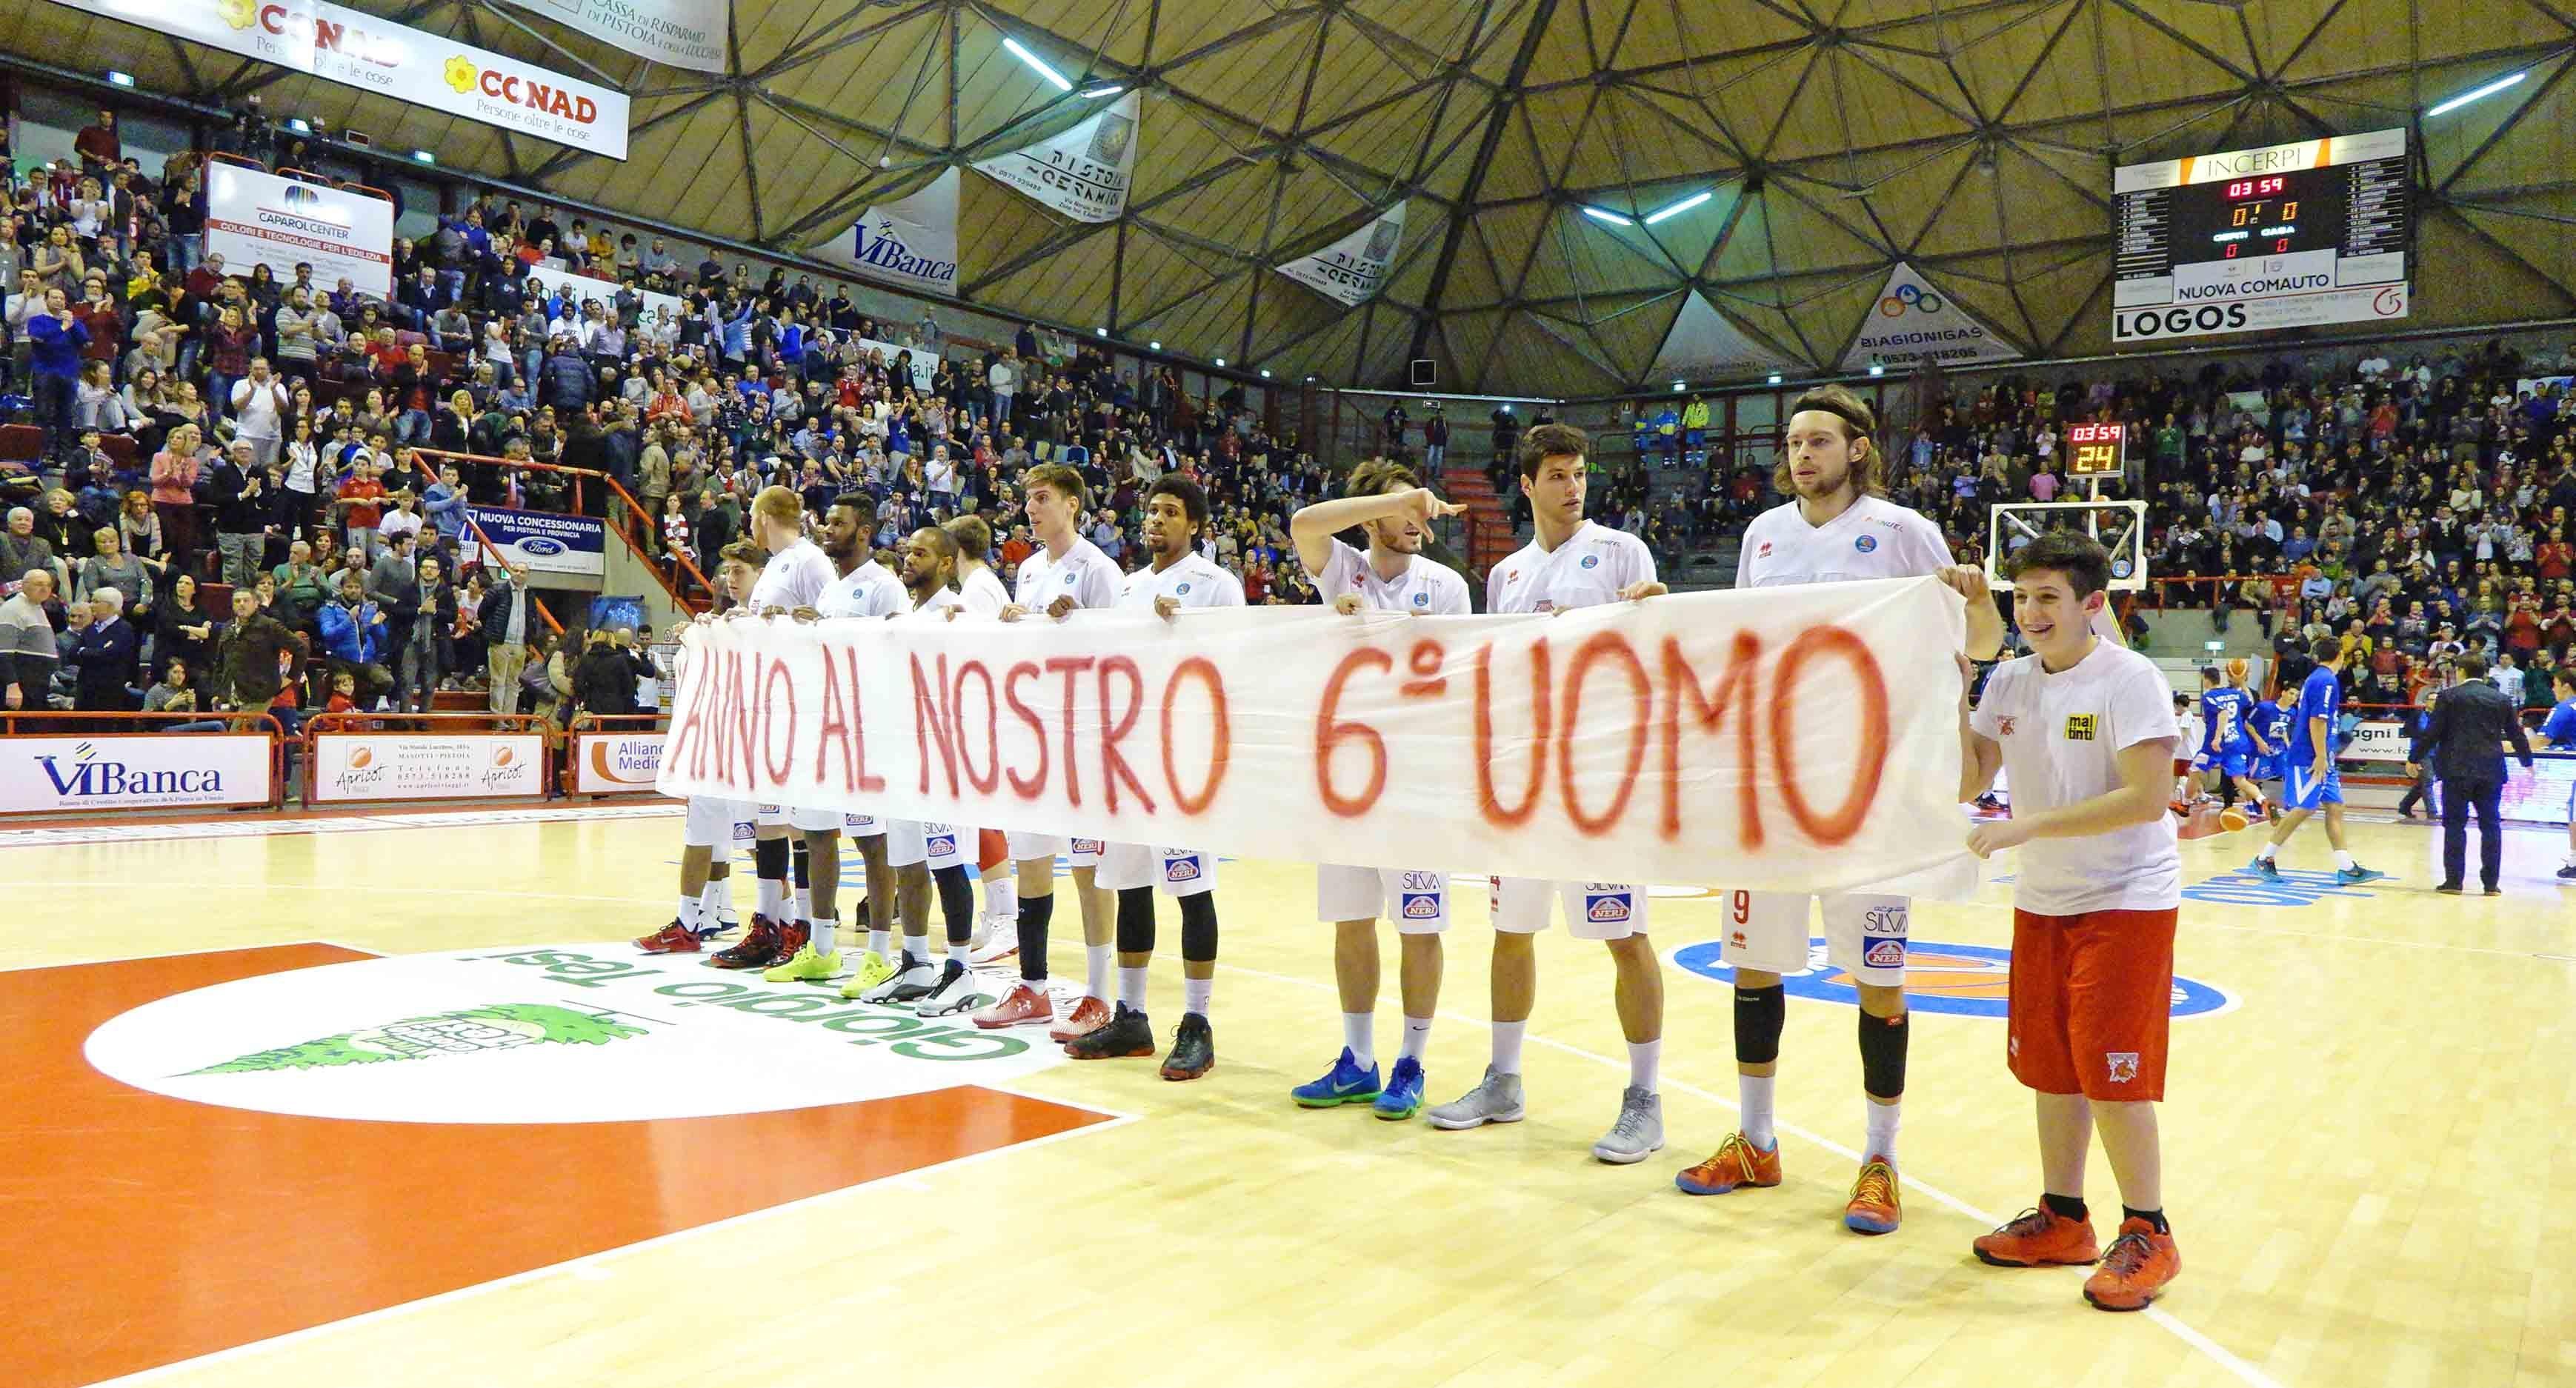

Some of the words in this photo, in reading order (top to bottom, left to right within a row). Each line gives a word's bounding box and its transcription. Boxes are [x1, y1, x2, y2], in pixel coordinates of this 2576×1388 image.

[602, 13, 655, 45] PISTOIA
[476, 98, 522, 121] Persone
[524, 113, 550, 129] oltre
[567, 127, 591, 141] cose
[2208, 147, 2300, 177] INCERPI
[220, 222, 256, 236] COLORI
[266, 230, 322, 249] TECNOLOGIE
[323, 241, 340, 253] PER
[2179, 283, 2236, 300] NUOVA
[2241, 274, 2329, 294] COMAUTO
[2117, 302, 2246, 338] LOGOS
[1861, 327, 1983, 348] BIAGIONIGAS
[2077, 445, 2114, 472] 24
[480, 513, 515, 524] NUOVA
[517, 516, 602, 533] CONCESSIONARIA
[516, 526, 540, 535] PISTOIA
[548, 530, 580, 538] PROVINCIA
[528, 541, 555, 554] Ford
[618, 741, 665, 755] Allianc
[815, 642, 886, 793] AL
[910, 652, 1231, 816] NOSTRO
[1474, 624, 1891, 851] UOMO
[618, 755, 660, 770] Medic
[336, 764, 389, 794] Apricot
[482, 762, 527, 791] Apricot
[1171, 870, 1194, 878] NERI
[1403, 871, 1440, 890] SILVA
[1594, 909, 1625, 918] NERI
[1734, 889, 1750, 924] 9
[1864, 912, 1908, 932] SILVA
[1872, 953, 1904, 963] NERI
